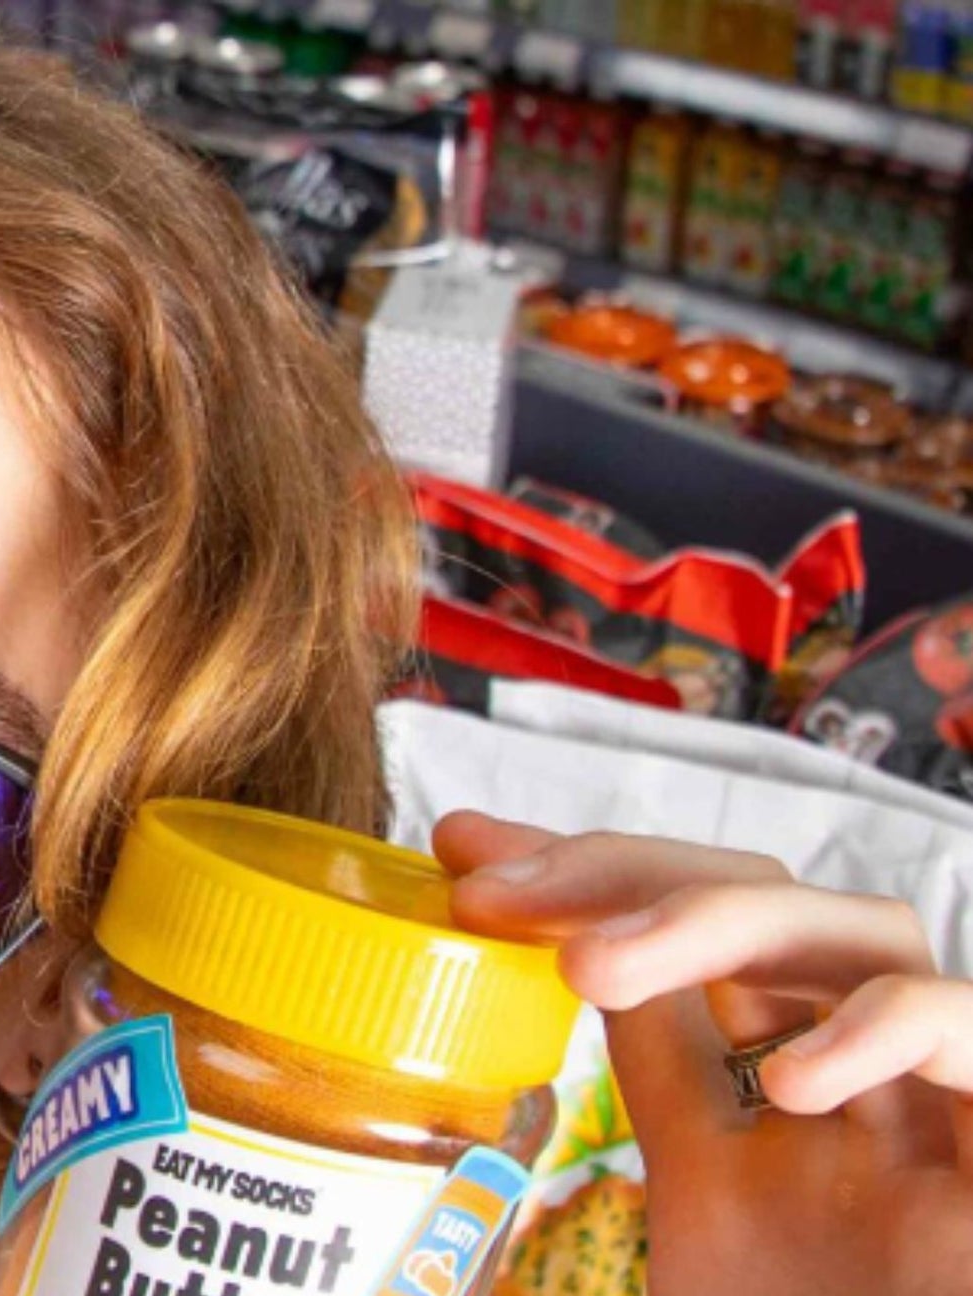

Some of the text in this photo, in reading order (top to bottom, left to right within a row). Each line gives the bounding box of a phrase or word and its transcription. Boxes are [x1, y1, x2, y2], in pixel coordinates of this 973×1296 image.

[16, 1054, 134, 1182] CREAMY
[152, 1143, 316, 1216] EAT MY SOCKS
[99, 1157, 355, 1294] Peanut
